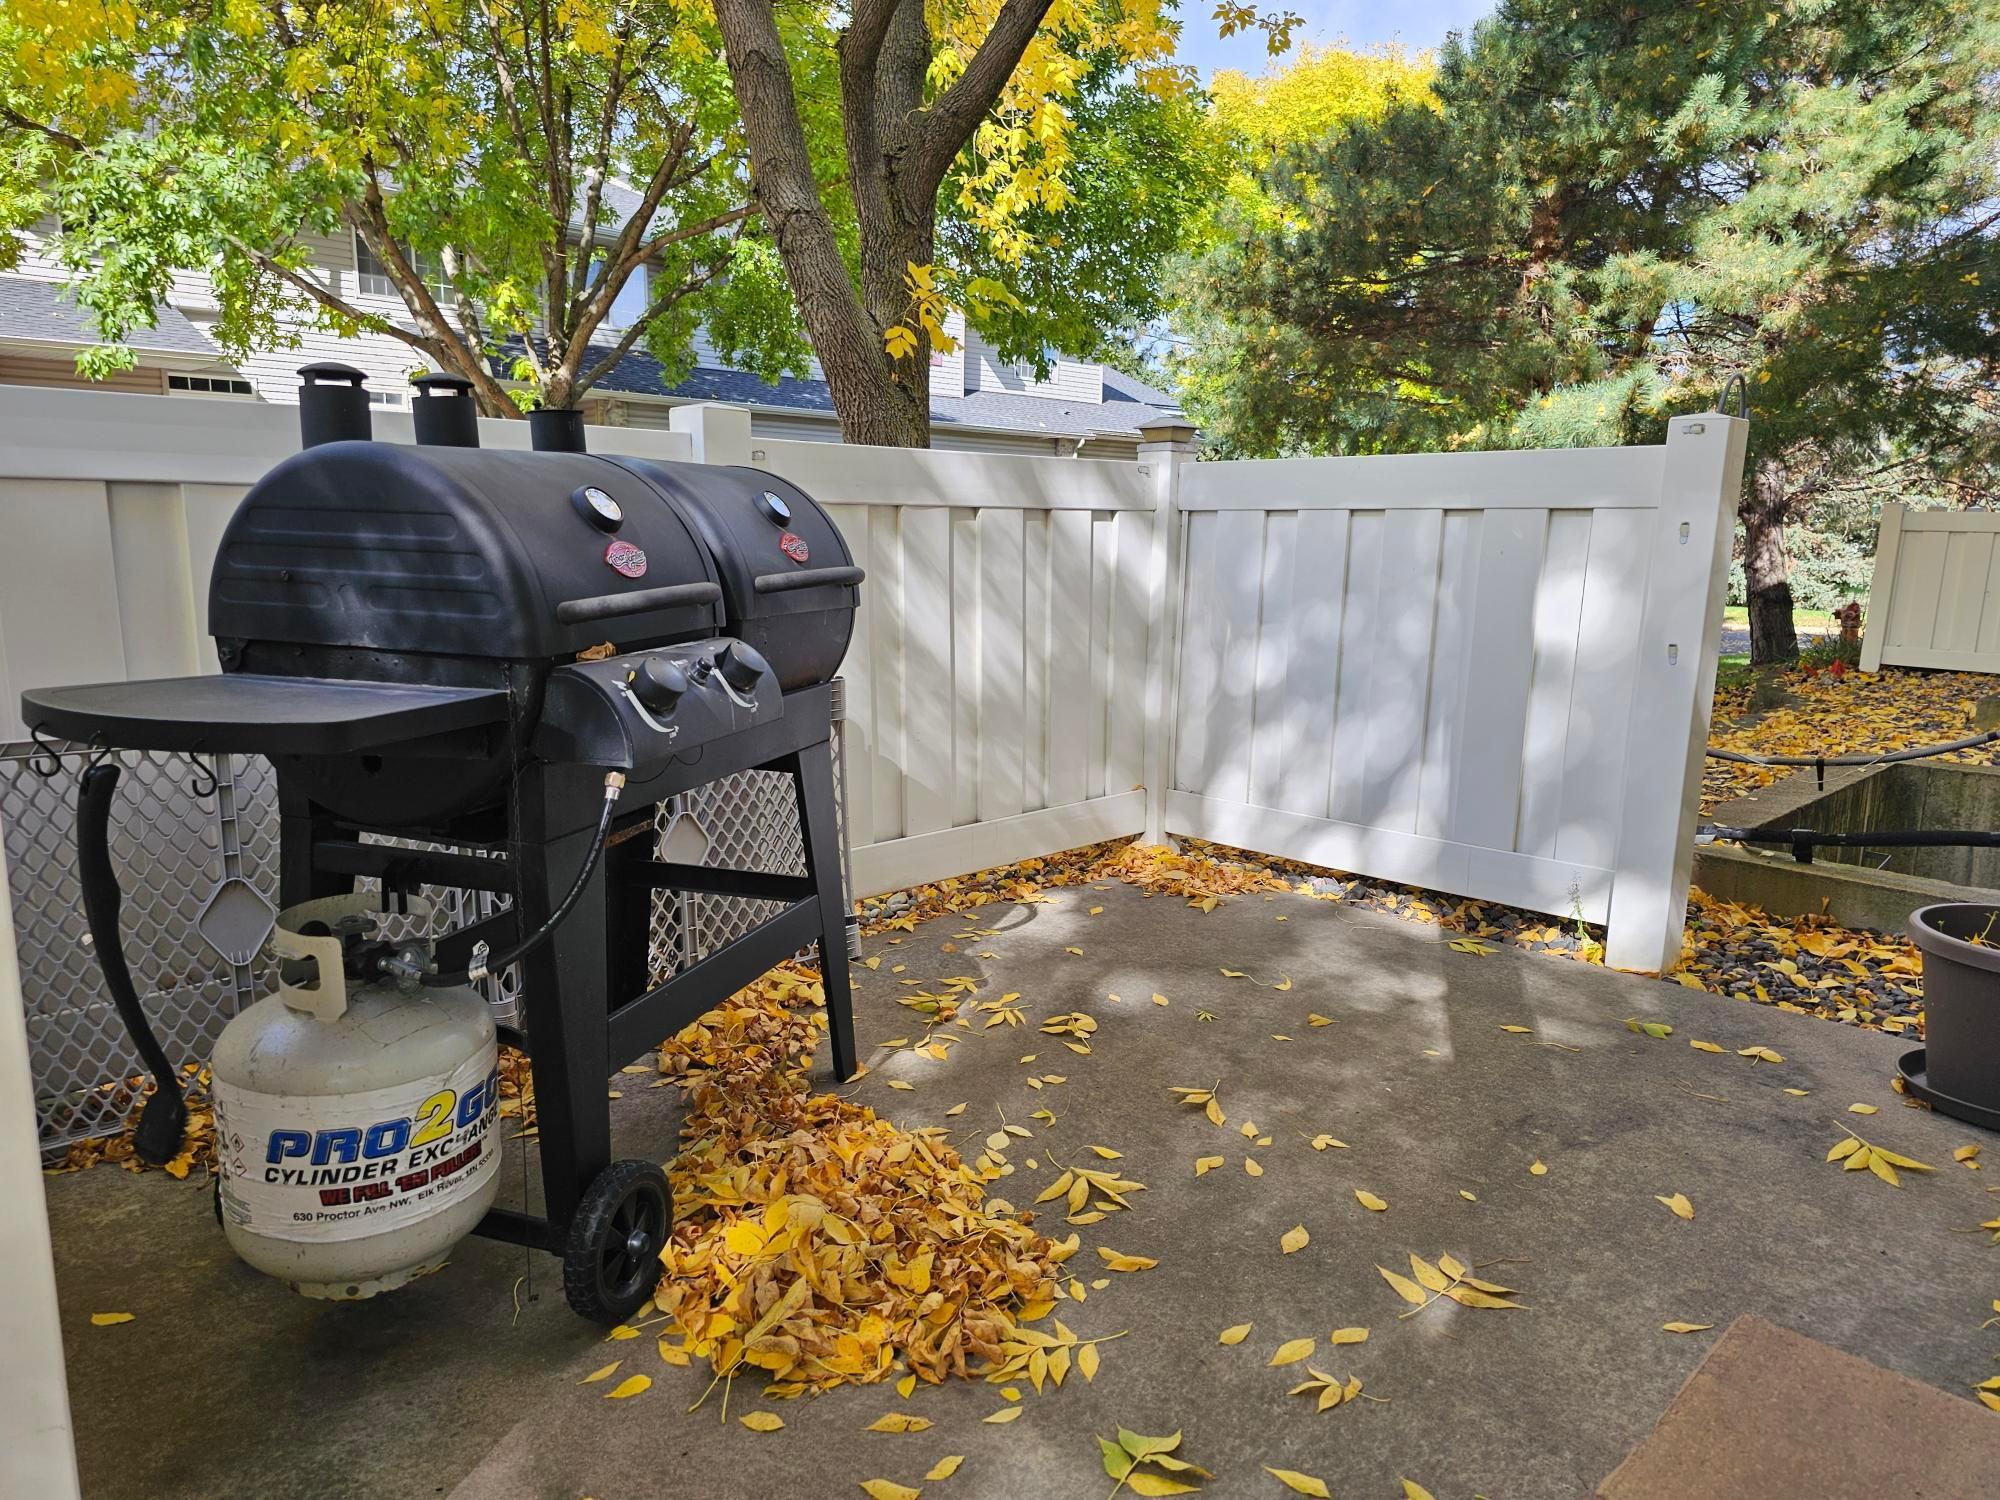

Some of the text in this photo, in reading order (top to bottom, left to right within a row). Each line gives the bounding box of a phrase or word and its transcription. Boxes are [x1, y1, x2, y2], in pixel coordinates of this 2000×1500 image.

[264, 1158, 398, 1186] CYLINDER
[292, 1212, 313, 1222] 630
[316, 1208, 360, 1222] Proctor
[389, 1198, 412, 1211] NW,
[418, 1187, 435, 1200] Elk
[318, 1188, 351, 1207] WE
[352, 1180, 393, 1204] FILL
